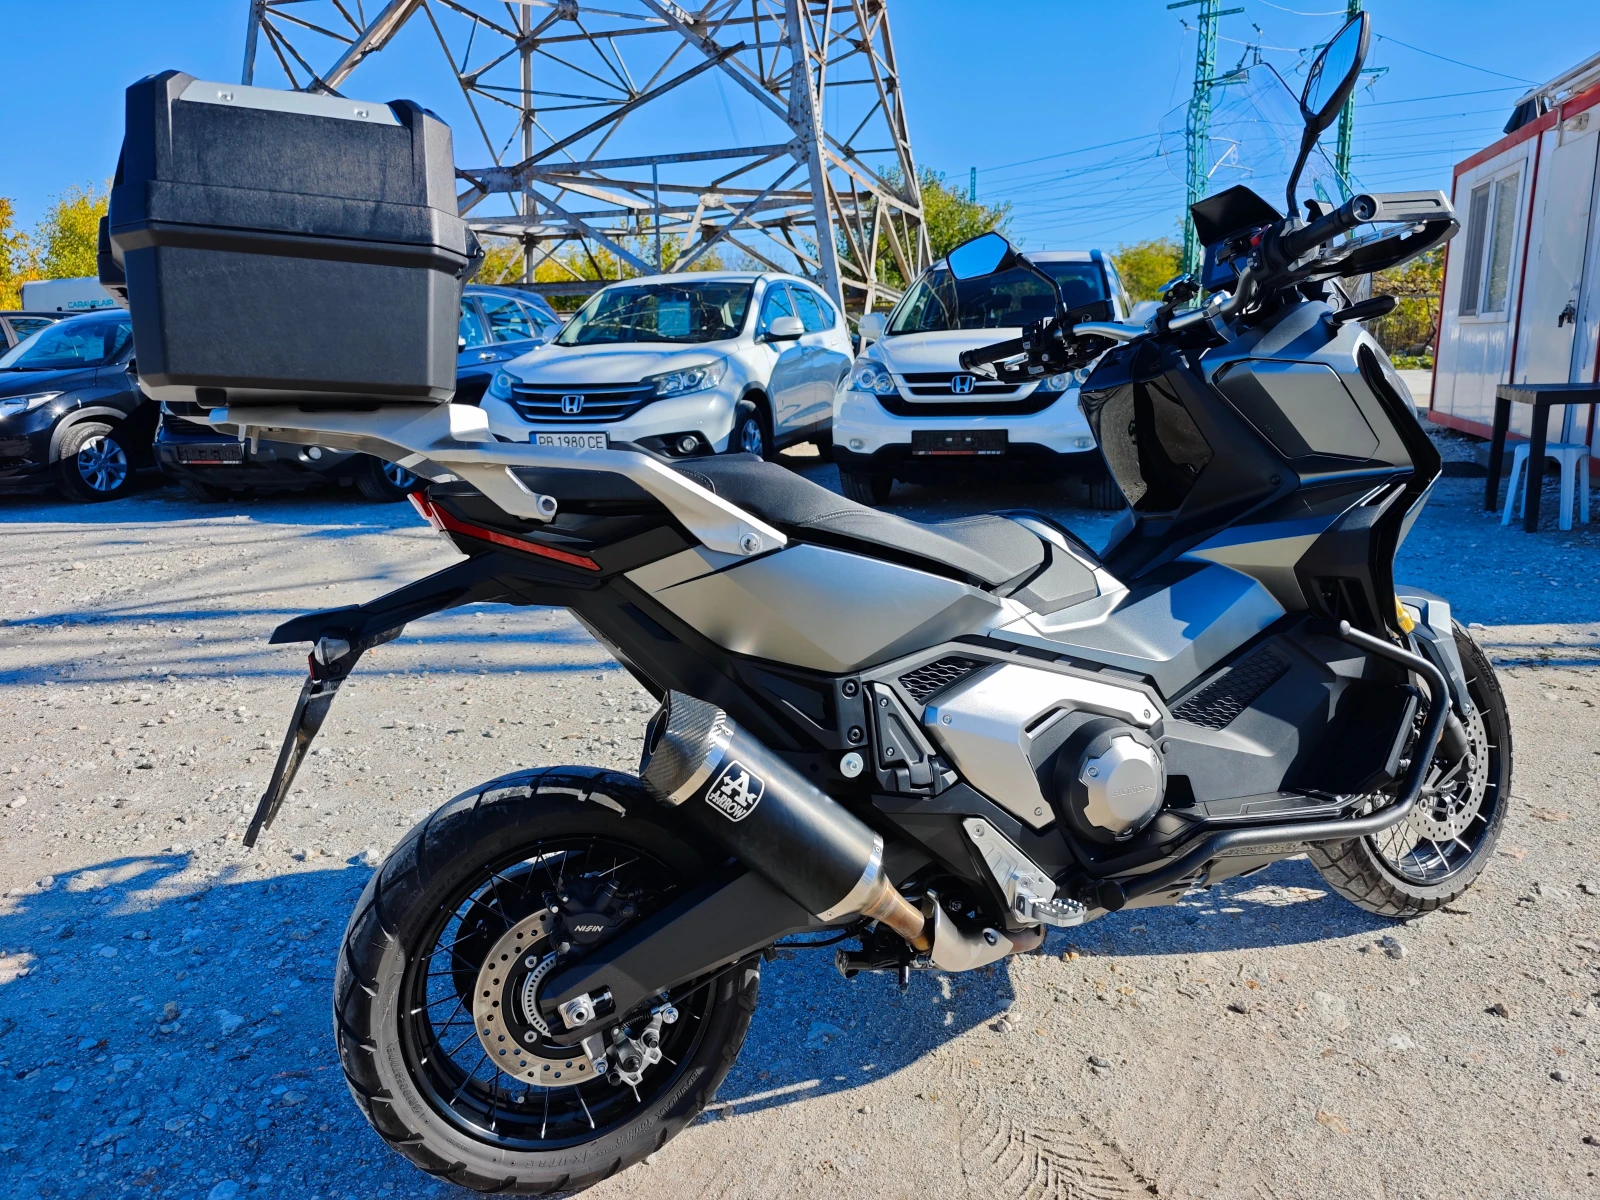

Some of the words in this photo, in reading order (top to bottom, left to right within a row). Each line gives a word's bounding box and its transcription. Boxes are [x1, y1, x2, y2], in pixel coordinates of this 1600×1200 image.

[68, 299, 114, 308] CARAVELAIR
[557, 436, 585, 448] 1980
[587, 436, 604, 449] CE
[709, 790, 747, 818] ARROW
